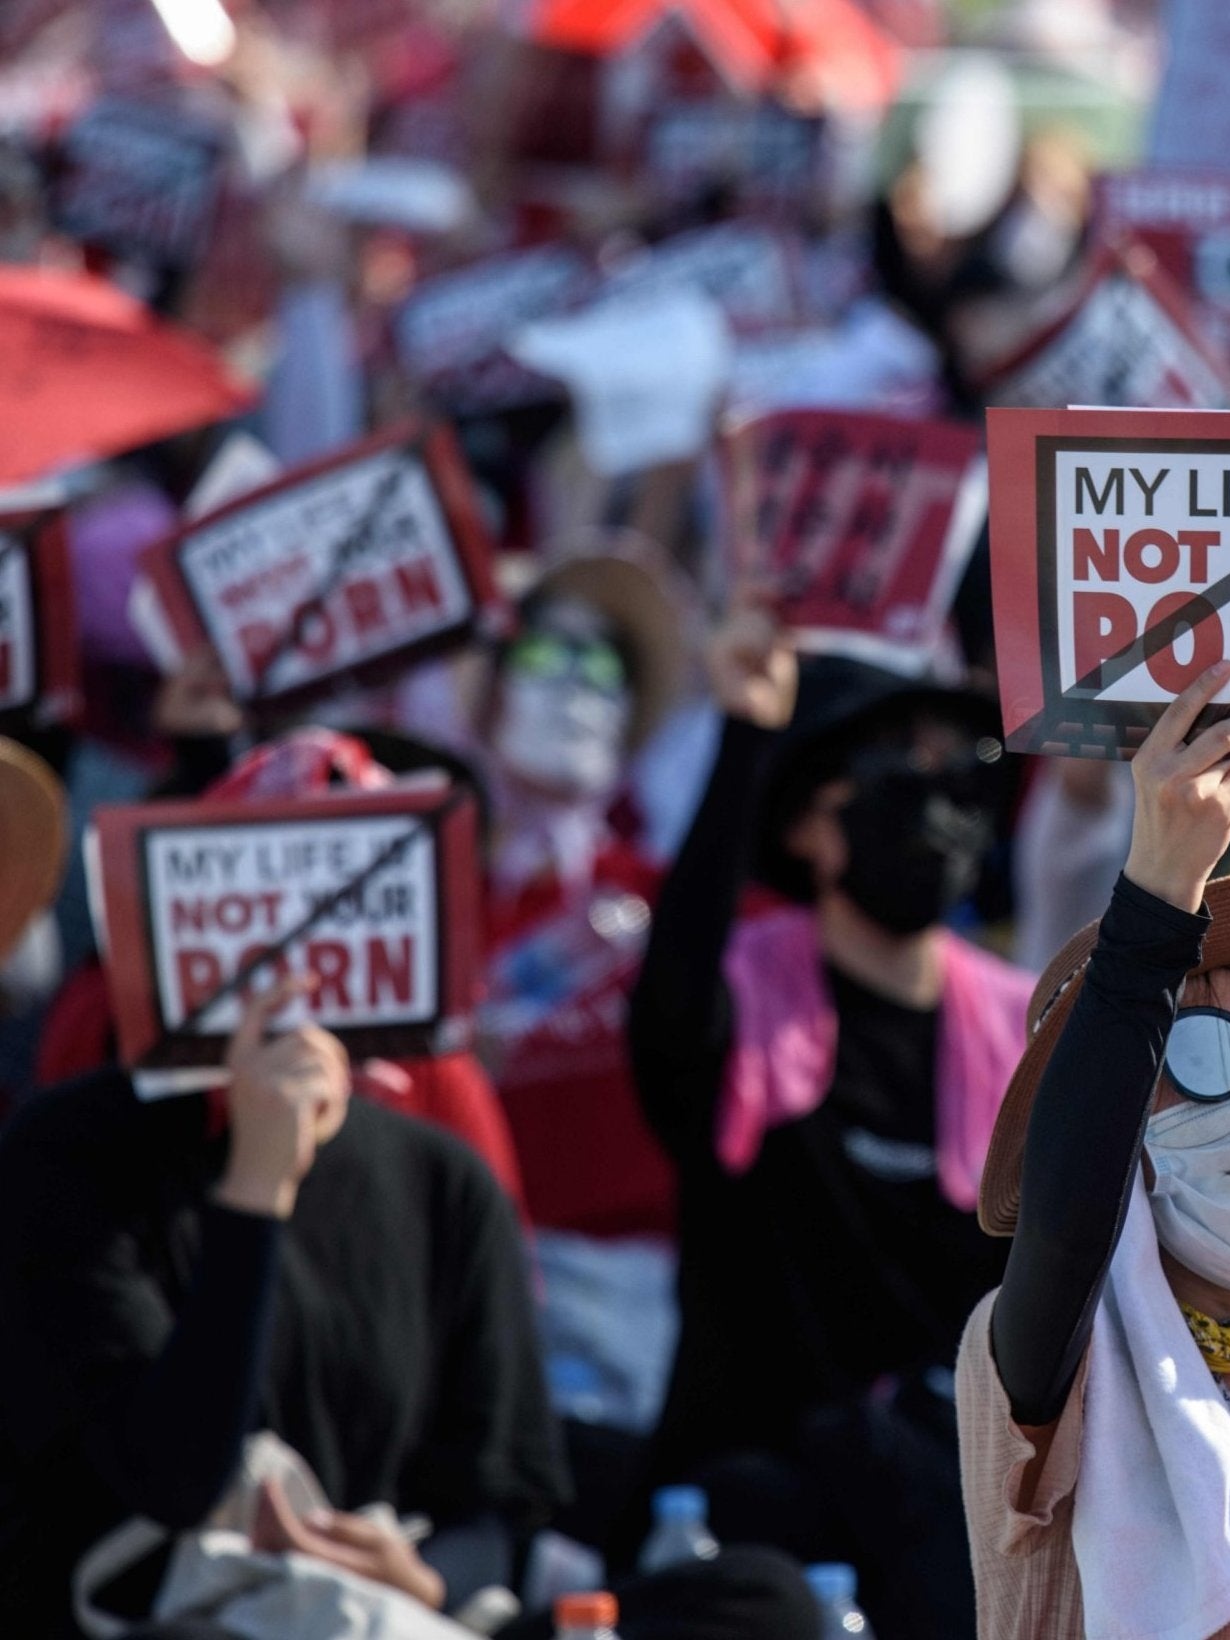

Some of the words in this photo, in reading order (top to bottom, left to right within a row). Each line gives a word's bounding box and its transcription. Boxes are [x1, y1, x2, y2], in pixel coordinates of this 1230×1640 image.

[1075, 467, 1170, 516] MY
[1073, 528, 1221, 584] NOT
[166, 843, 241, 883] MY
[256, 838, 350, 881] LIFE
[170, 893, 283, 935] NOT
[177, 935, 414, 1022] PORN
